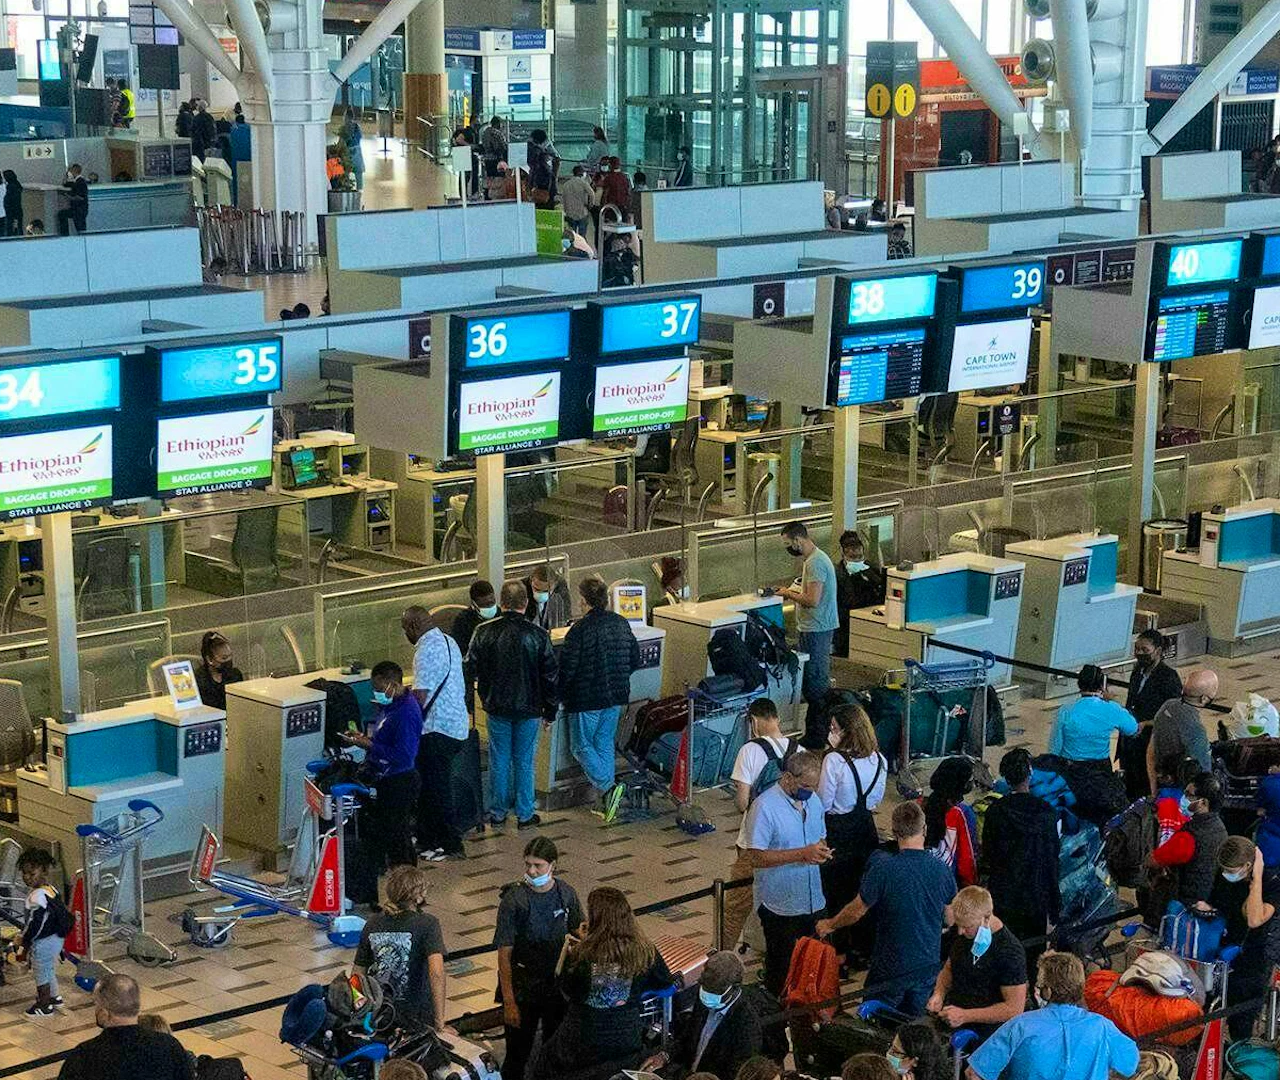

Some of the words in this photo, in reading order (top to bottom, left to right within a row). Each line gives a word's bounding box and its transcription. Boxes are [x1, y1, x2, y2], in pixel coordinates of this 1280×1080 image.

[1170, 250, 1199, 278] 40
[1011, 268, 1042, 299] 39
[851, 283, 884, 317] 38
[660, 302, 697, 338] 37
[469, 322, 508, 358] 36
[235, 346, 277, 385] 35
[966, 354, 987, 366] CAPE
[989, 352, 1017, 363] TOWN
[601, 381, 667, 399] Ethiopian
[468, 396, 536, 416] Ethiopian
[605, 414, 638, 425] BAGGAGE
[639, 410, 675, 421] DROP-OFF
[471, 431, 506, 444] BAGGAGE
[507, 426, 547, 439] DROP-OFF
[607, 429, 626, 437] STAR
[626, 424, 663, 435] ALLIANCE
[166, 433, 246, 454] Ethiopian
[475, 446, 493, 455] STAR
[494, 442, 533, 453] ALLIANCE
[171, 472, 213, 484] BAGGAGE
[214, 466, 258, 479] DROP-OFF
[4, 491, 48, 505] BAGGAGE
[49, 485, 97, 499] DROP-OFF
[175, 486, 197, 496] STAR
[198, 481, 243, 494] ALLIANCE
[9, 507, 32, 518] STAR
[33, 501, 81, 515] ALLIANCE
